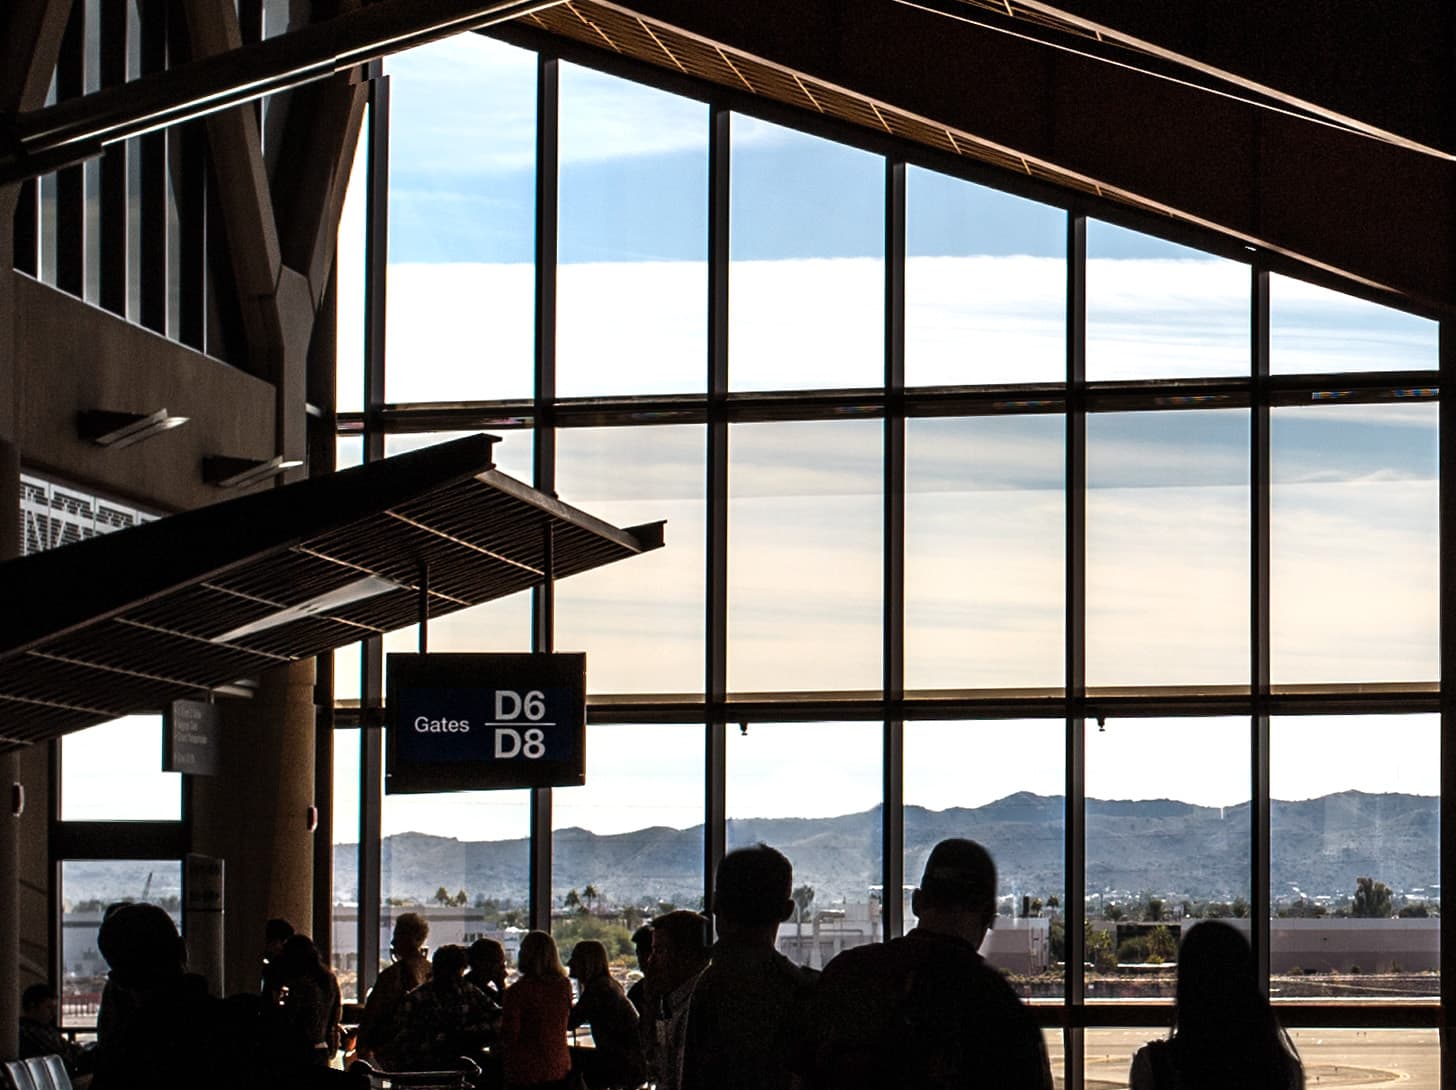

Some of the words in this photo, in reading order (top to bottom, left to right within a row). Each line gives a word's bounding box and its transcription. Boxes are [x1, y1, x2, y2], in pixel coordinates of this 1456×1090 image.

[494, 690, 546, 721] D6
[414, 716, 470, 733] Gates
[494, 728, 546, 759] D8
